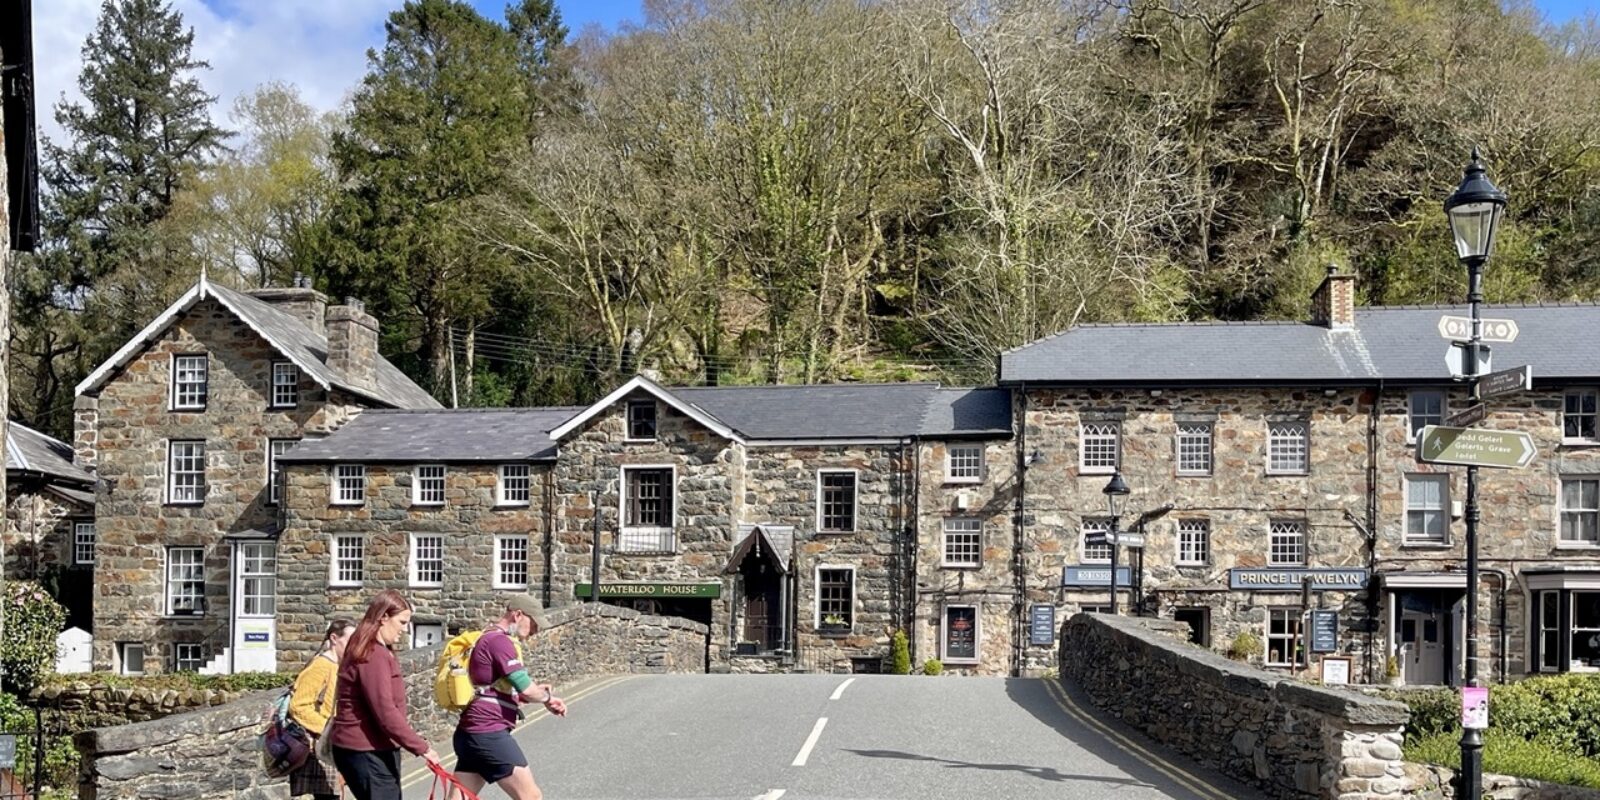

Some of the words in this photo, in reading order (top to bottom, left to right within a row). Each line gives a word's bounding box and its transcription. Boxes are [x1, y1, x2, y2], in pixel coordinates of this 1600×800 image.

[1478, 435, 1503, 443] Gelert
[1488, 445, 1512, 453] Grave
[1239, 573, 1287, 585] PRINCE
[1290, 573, 1359, 585] LLWELYN
[599, 585, 655, 594] WATERLOO
[663, 585, 697, 594] HOUSE
